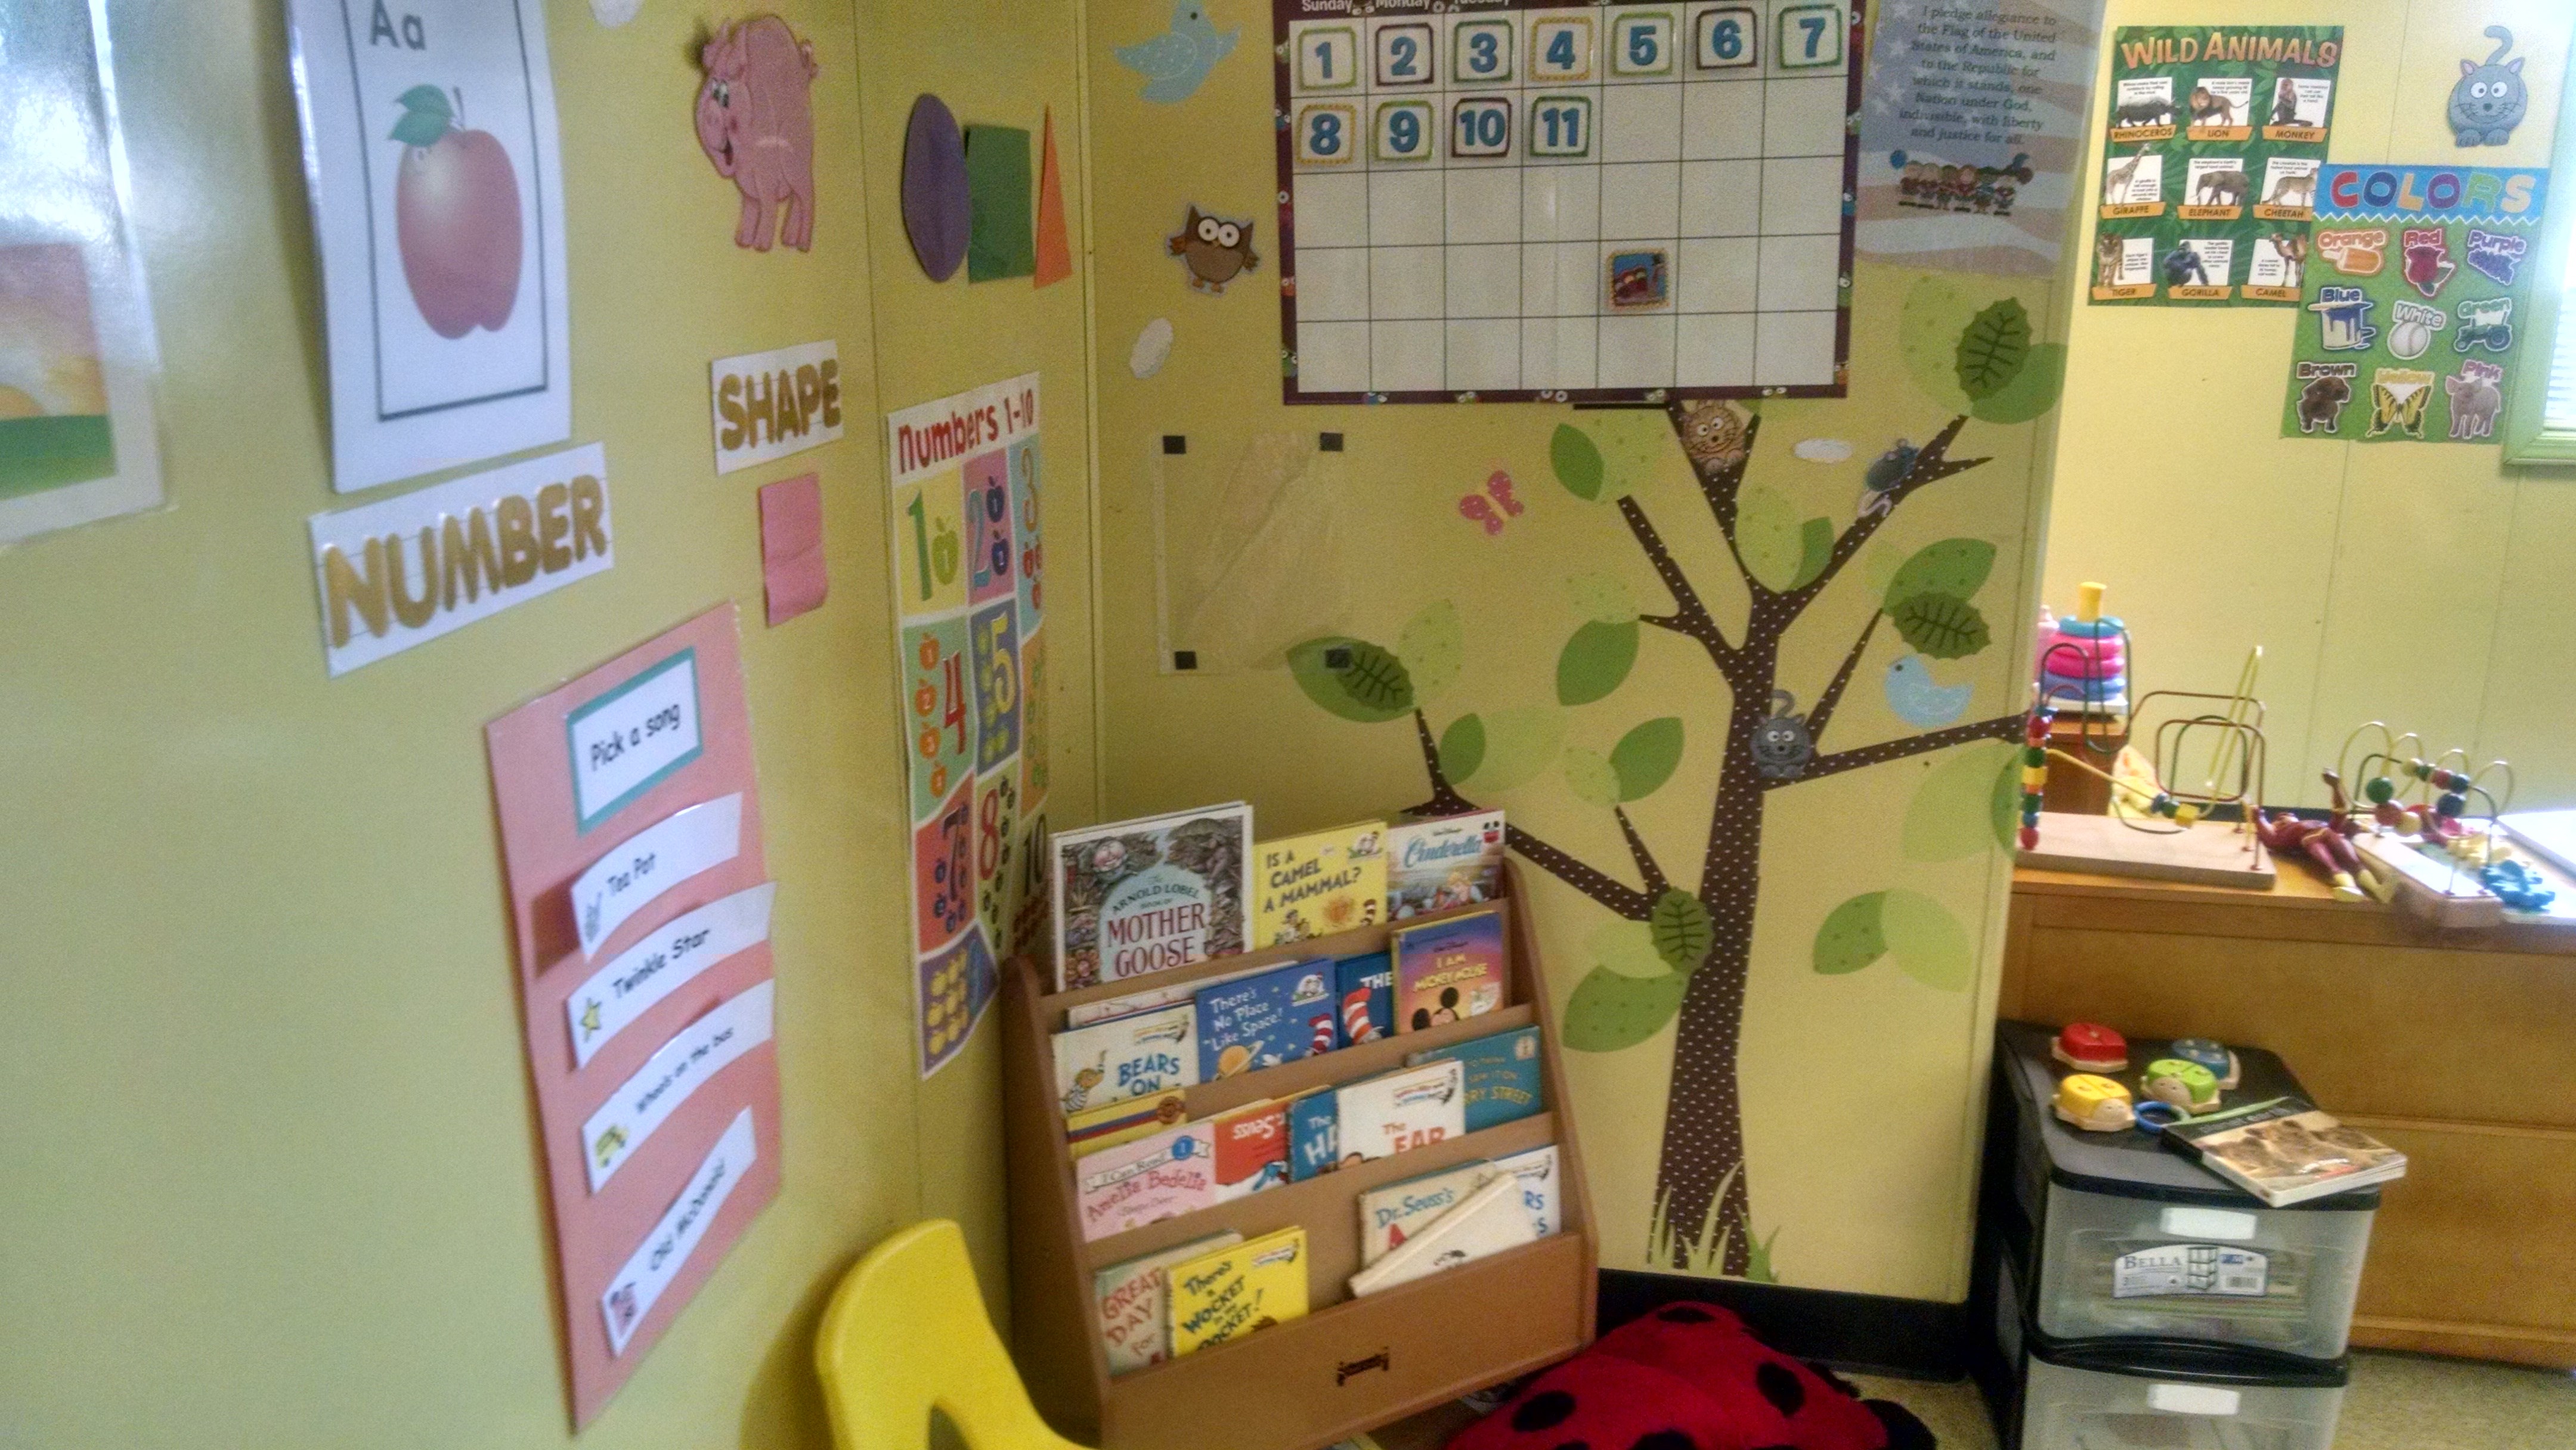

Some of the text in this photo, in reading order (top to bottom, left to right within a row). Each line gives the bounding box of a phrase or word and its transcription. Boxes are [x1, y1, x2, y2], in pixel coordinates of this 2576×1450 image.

[1302, 0, 1352, 13] Sunday
[369, 3, 426, 51] Aa
[2014, 30, 2057, 43] United
[1315, 18, 1826, 80] 1 2 3 4 5 6 7
[2031, 49, 2056, 61] and
[2120, 31, 2338, 70] WILD ANIMALS
[1309, 107, 1580, 156] 8 9 10 11
[2114, 127, 2172, 139] RHINOCEROS
[2207, 129, 2230, 138] LION
[2275, 130, 2315, 140] MONKEY
[2330, 170, 2537, 213] COLORS
[2113, 205, 2150, 215] GIRAFFE
[2188, 209, 2233, 217] ELEPHANT
[2264, 208, 2304, 218] CHEETAH
[2318, 229, 2386, 249] Orange
[2402, 228, 2442, 247] Red
[2468, 229, 2527, 255] Purple
[2111, 288, 2137, 297] TIGER
[2181, 289, 2219, 297] GORILLA
[2255, 288, 2286, 298] CAMEL
[2321, 287, 2363, 303] Blue
[2394, 302, 2444, 329] White
[2297, 362, 2357, 379] Brown
[718, 358, 841, 451] SHAPE
[1004, 388, 1034, 435] 1-10
[907, 489, 933, 602] 1
[324, 475, 606, 649] NUMBER
[991, 610, 1015, 714] 5
[942, 650, 967, 755] 4
[589, 704, 681, 772] Pick a song
[979, 788, 1000, 881] 8
[1266, 851, 1294, 870] IS A
[1403, 835, 1484, 868] Cinderella
[1270, 858, 1322, 890] CAMEL
[1112, 884, 1200, 915] ARNOLD LOBEL
[1262, 866, 1362, 913] A MAMMAL?
[1107, 901, 1206, 948] MOTHER
[612, 928, 711, 999] Twinkle Star
[1115, 935, 1196, 978] GOOSE
[1359, 971, 1394, 990] THE
[1208, 986, 1257, 1014] There's
[1213, 1002, 1270, 1033] No Place
[674, 1061, 688, 1078] on
[689, 1043, 710, 1064] the
[712, 1026, 734, 1048] bus
[1211, 1032, 1240, 1052] Like
[1117, 1052, 1181, 1088] BEARS
[1130, 1075, 1161, 1096] ON
[1381, 1121, 1407, 1135] The
[1394, 1126, 1446, 1155] EAR
[1147, 1169, 1207, 1192] Bedelia
[2123, 1256, 2181, 1269] BELLA
[1103, 1266, 1162, 1321] GREAT
[1181, 1274, 1245, 1334] WOCKET
[1104, 1297, 1153, 1348] DAY
